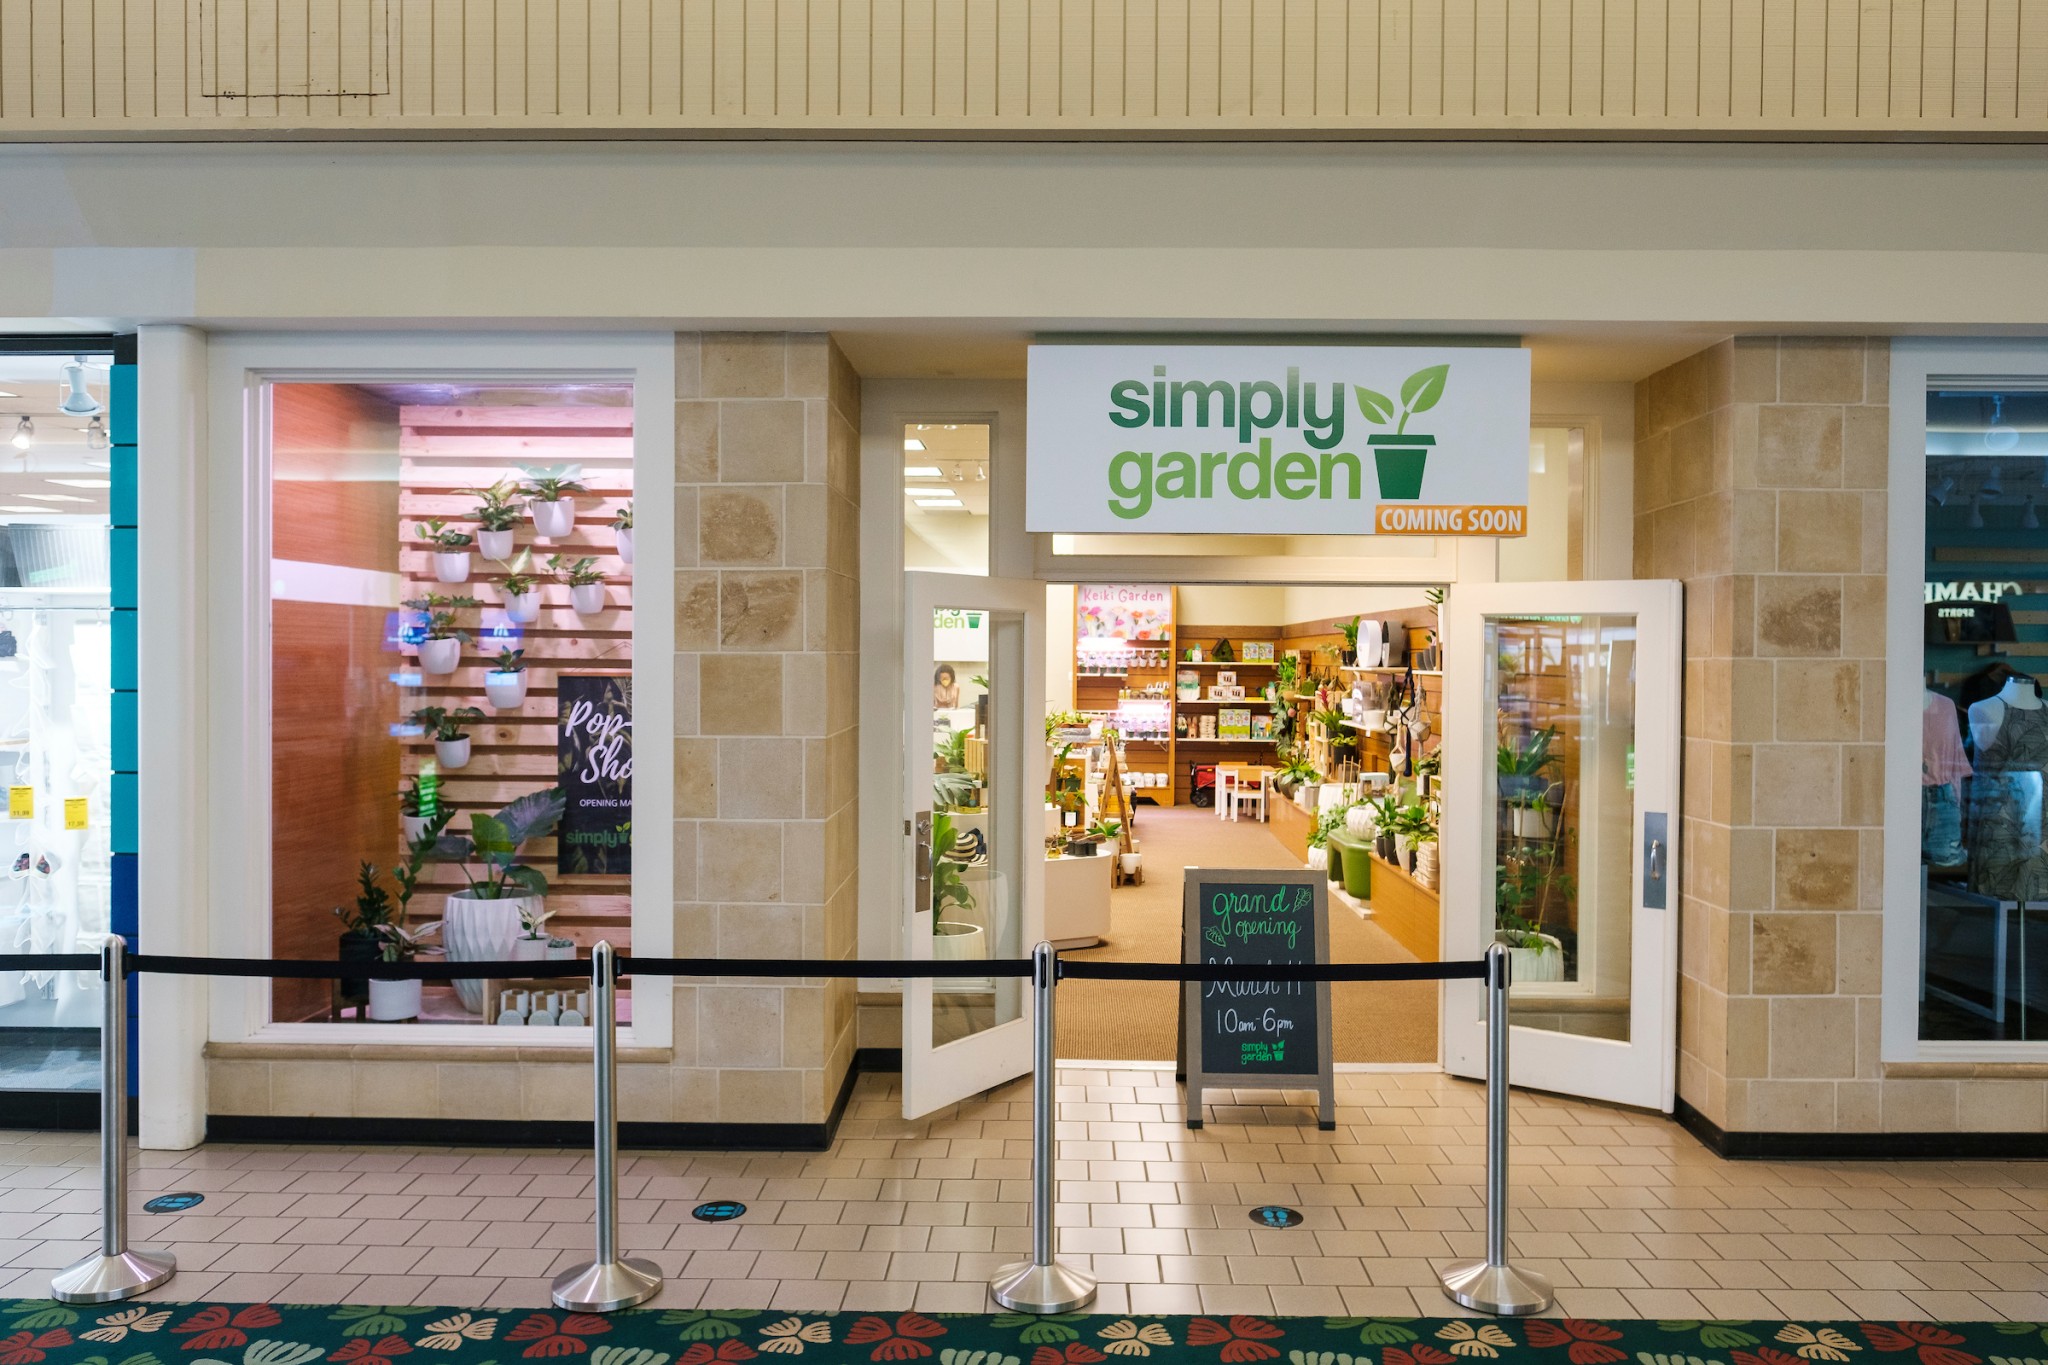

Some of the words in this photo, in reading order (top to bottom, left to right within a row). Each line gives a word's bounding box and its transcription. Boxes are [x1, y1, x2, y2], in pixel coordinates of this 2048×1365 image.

[1108, 364, 1345, 450] simply
[1107, 437, 1362, 520] garden
[1380, 507, 1463, 532] COMING
[1467, 508, 1522, 533] SOON
[1083, 588, 1114, 602] Keiki
[1118, 588, 1164, 603] Garden
[579, 799, 618, 808] OPENING
[566, 829, 617, 848] simply
[1213, 886, 1290, 935] grand
[1235, 917, 1302, 950] opening
[1241, 1041, 1269, 1054] simply
[1241, 1051, 1273, 1065] garden
